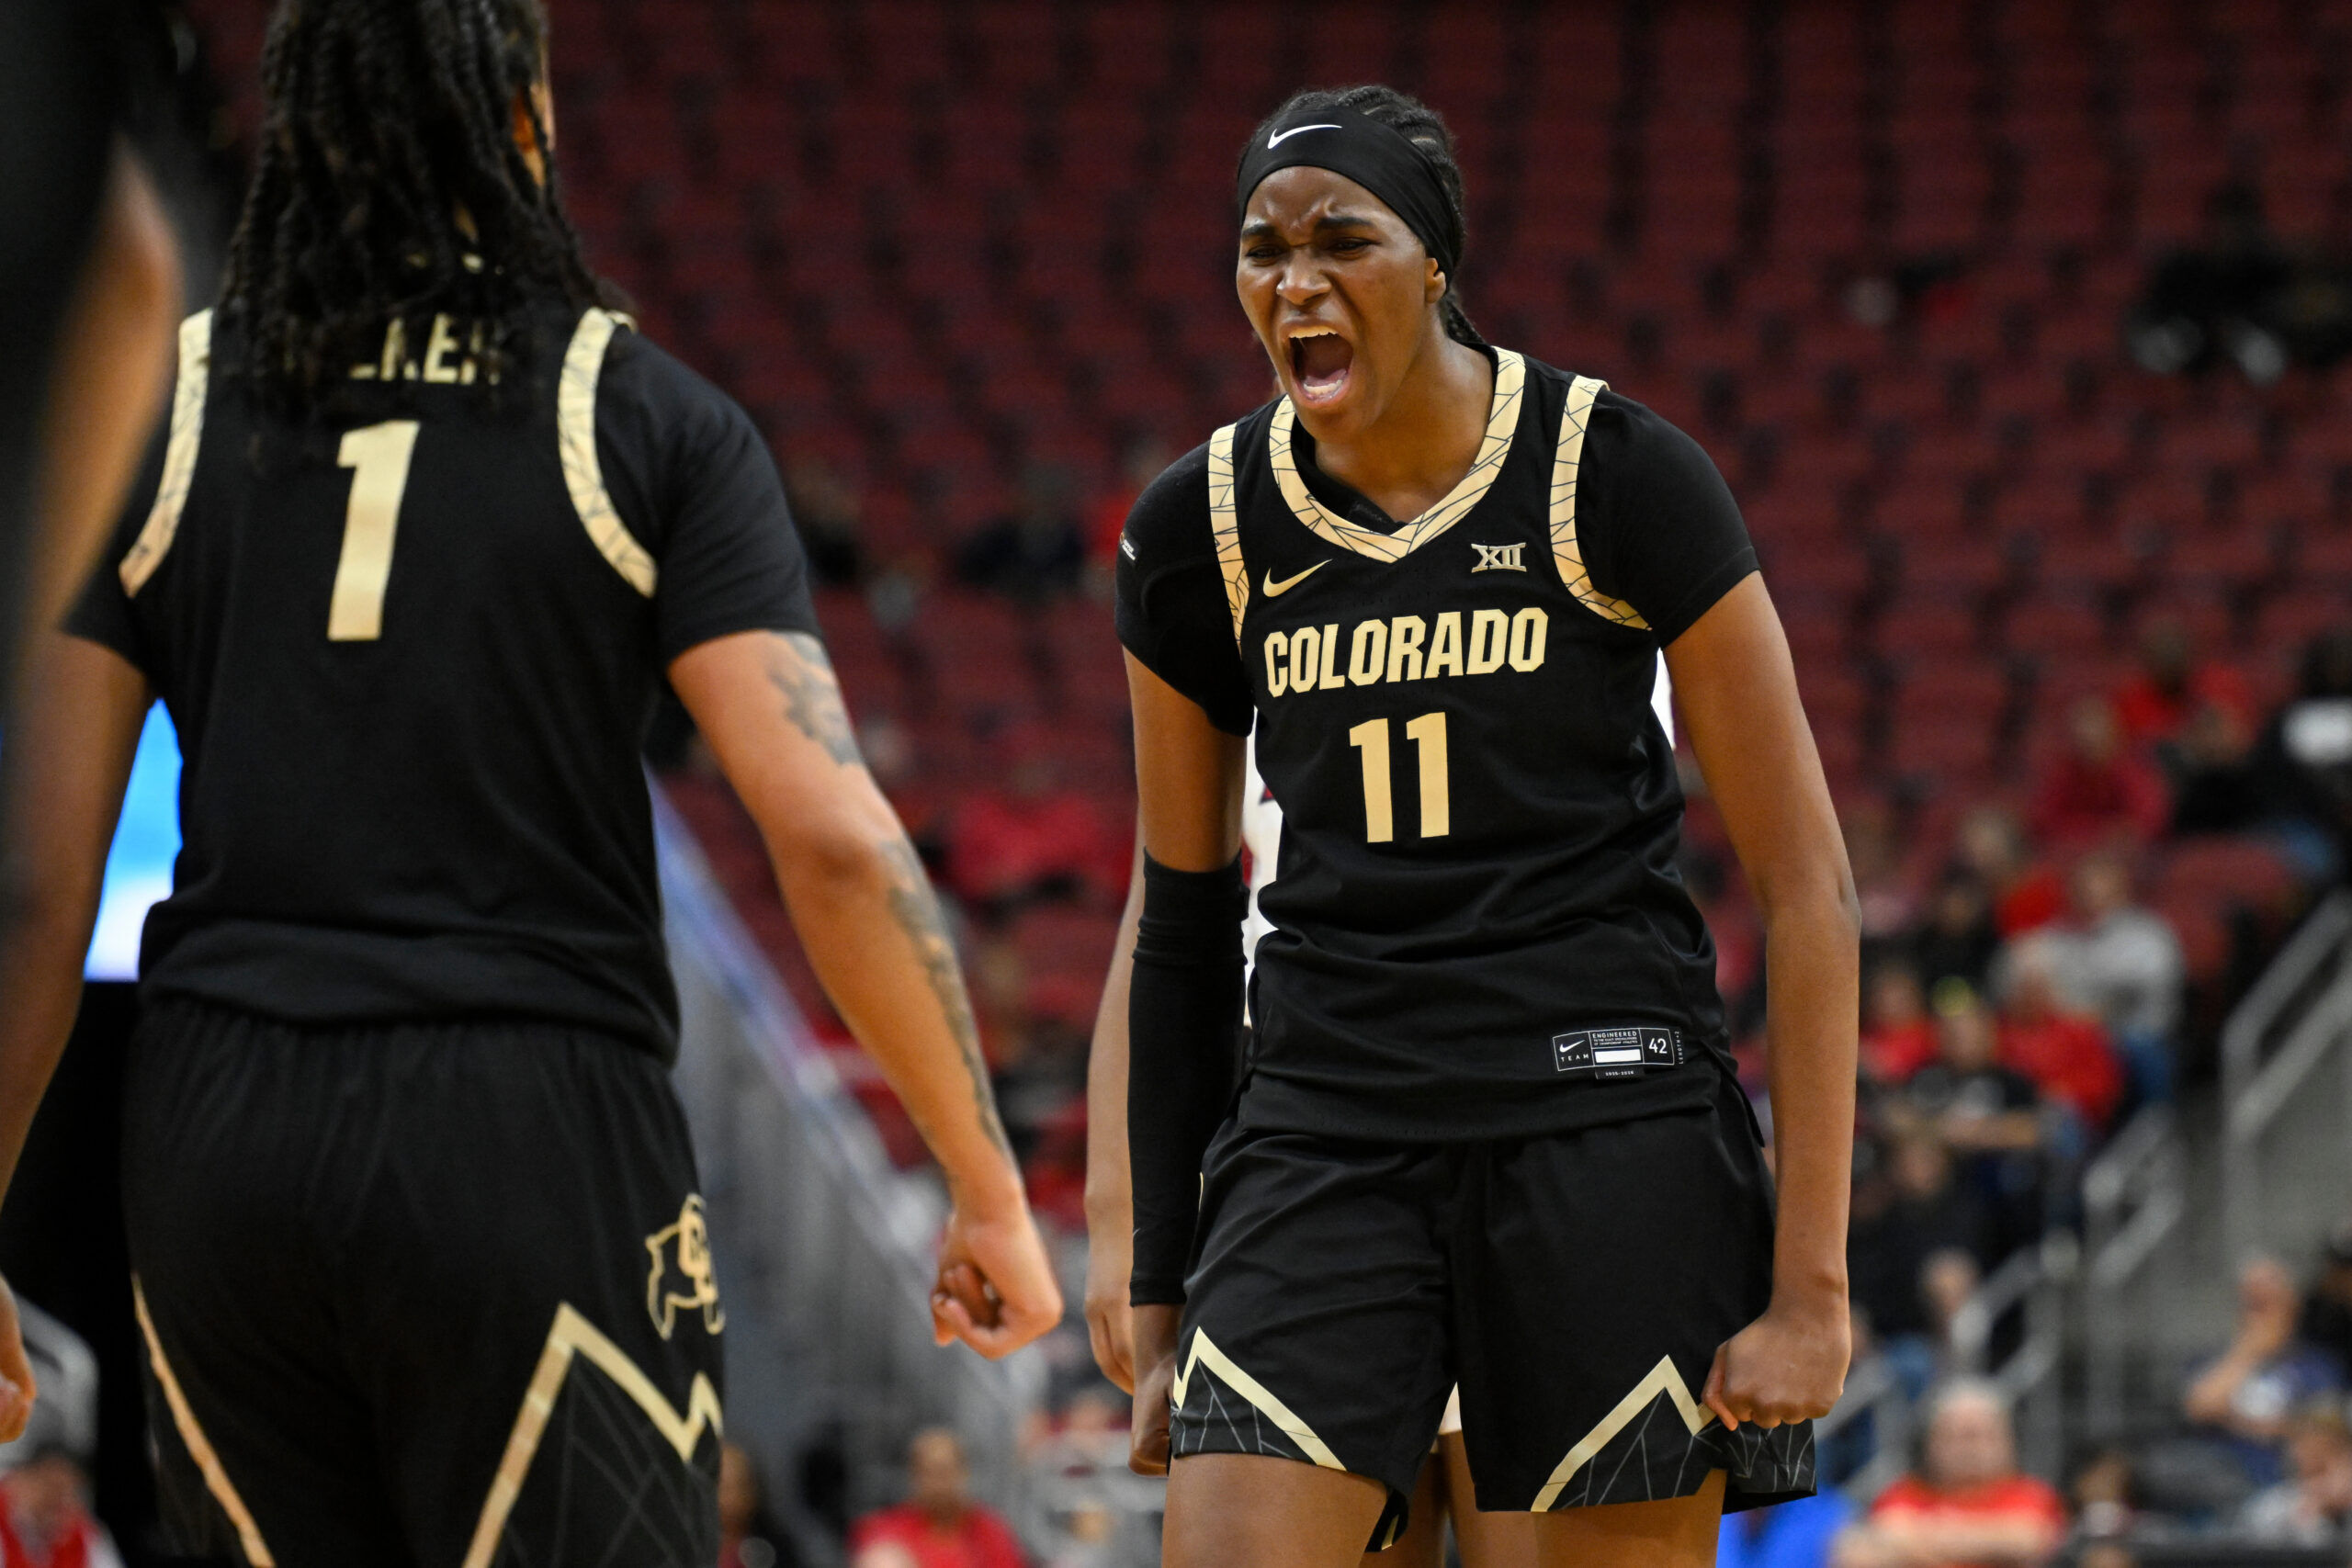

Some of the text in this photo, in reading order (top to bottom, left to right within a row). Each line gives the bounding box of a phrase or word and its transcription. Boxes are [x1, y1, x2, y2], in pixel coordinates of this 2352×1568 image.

[327, 419, 421, 641] 1
[1471, 542, 1527, 572] XII
[1263, 607, 1549, 698] COLORADO
[1349, 712, 1450, 843] 11
[1592, 1031, 1637, 1039] ENGINEERED
[1648, 1037, 1668, 1054] 42
[1561, 1054, 1589, 1062] TEAM
